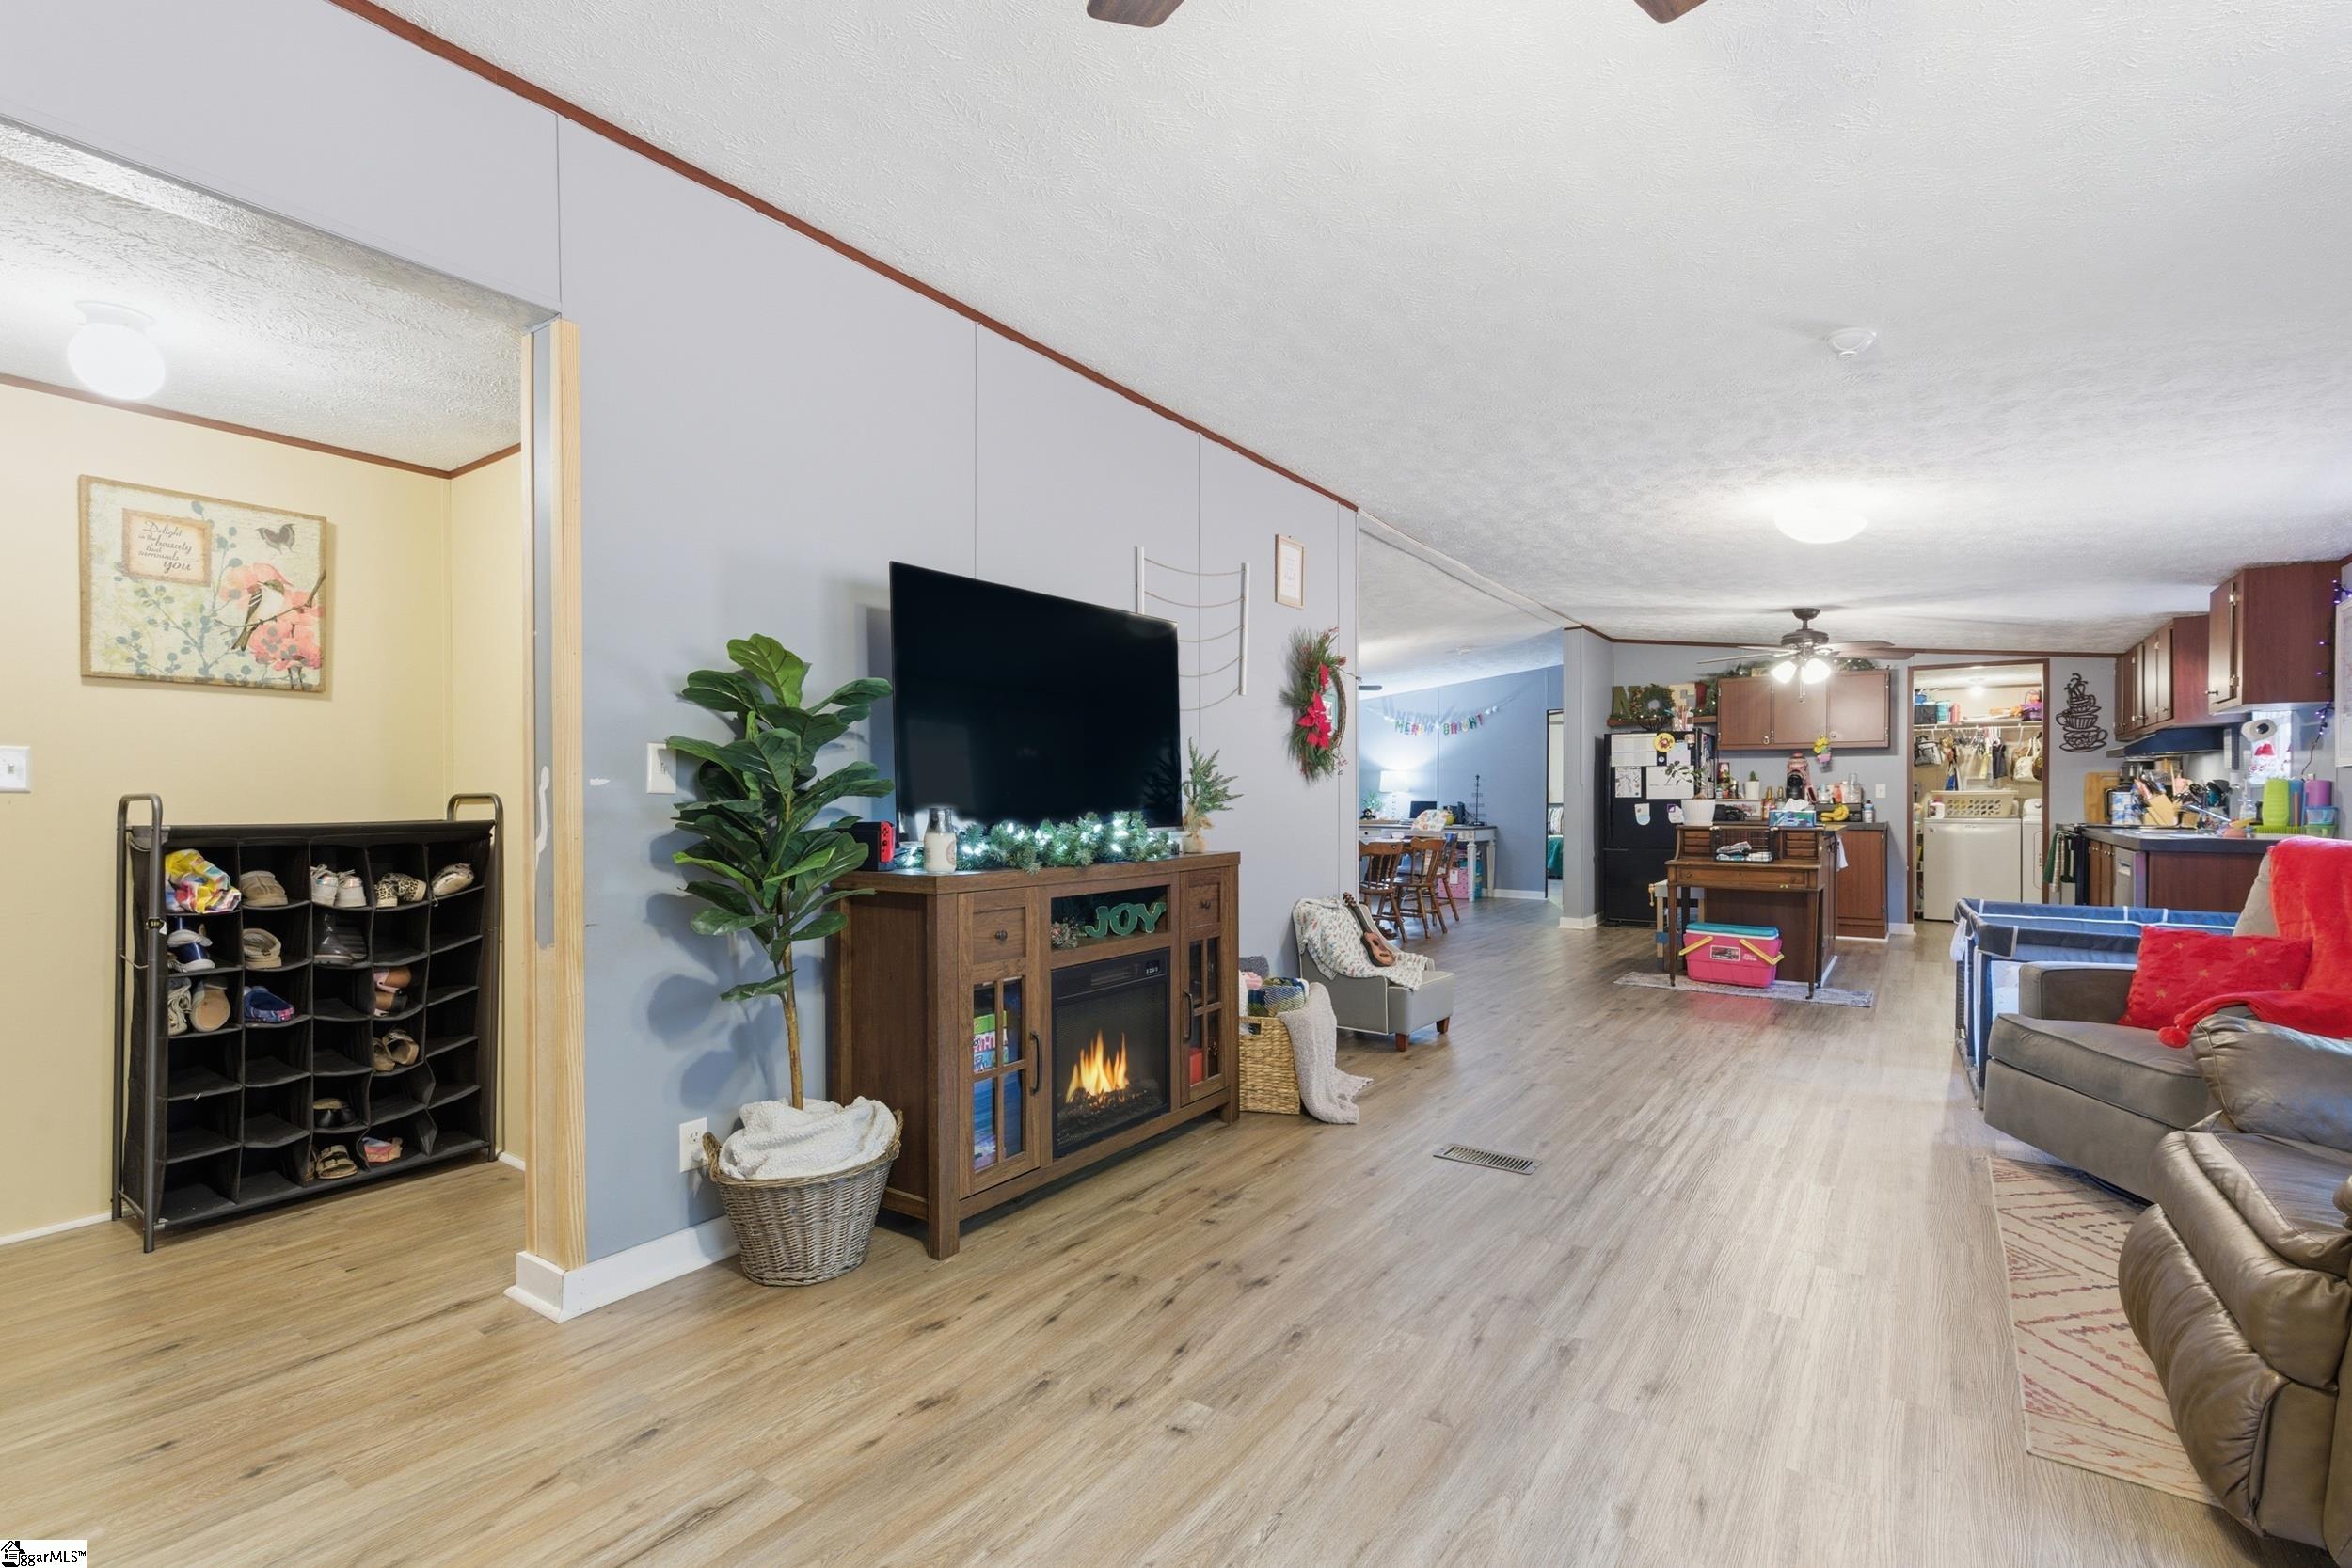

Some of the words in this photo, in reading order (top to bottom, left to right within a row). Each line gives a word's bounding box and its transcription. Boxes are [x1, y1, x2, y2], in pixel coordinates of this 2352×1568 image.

[143, 519, 183, 538] Delight
[147, 532, 156, 541] the
[164, 561, 192, 574] you
[1084, 902, 1166, 938] JOY
